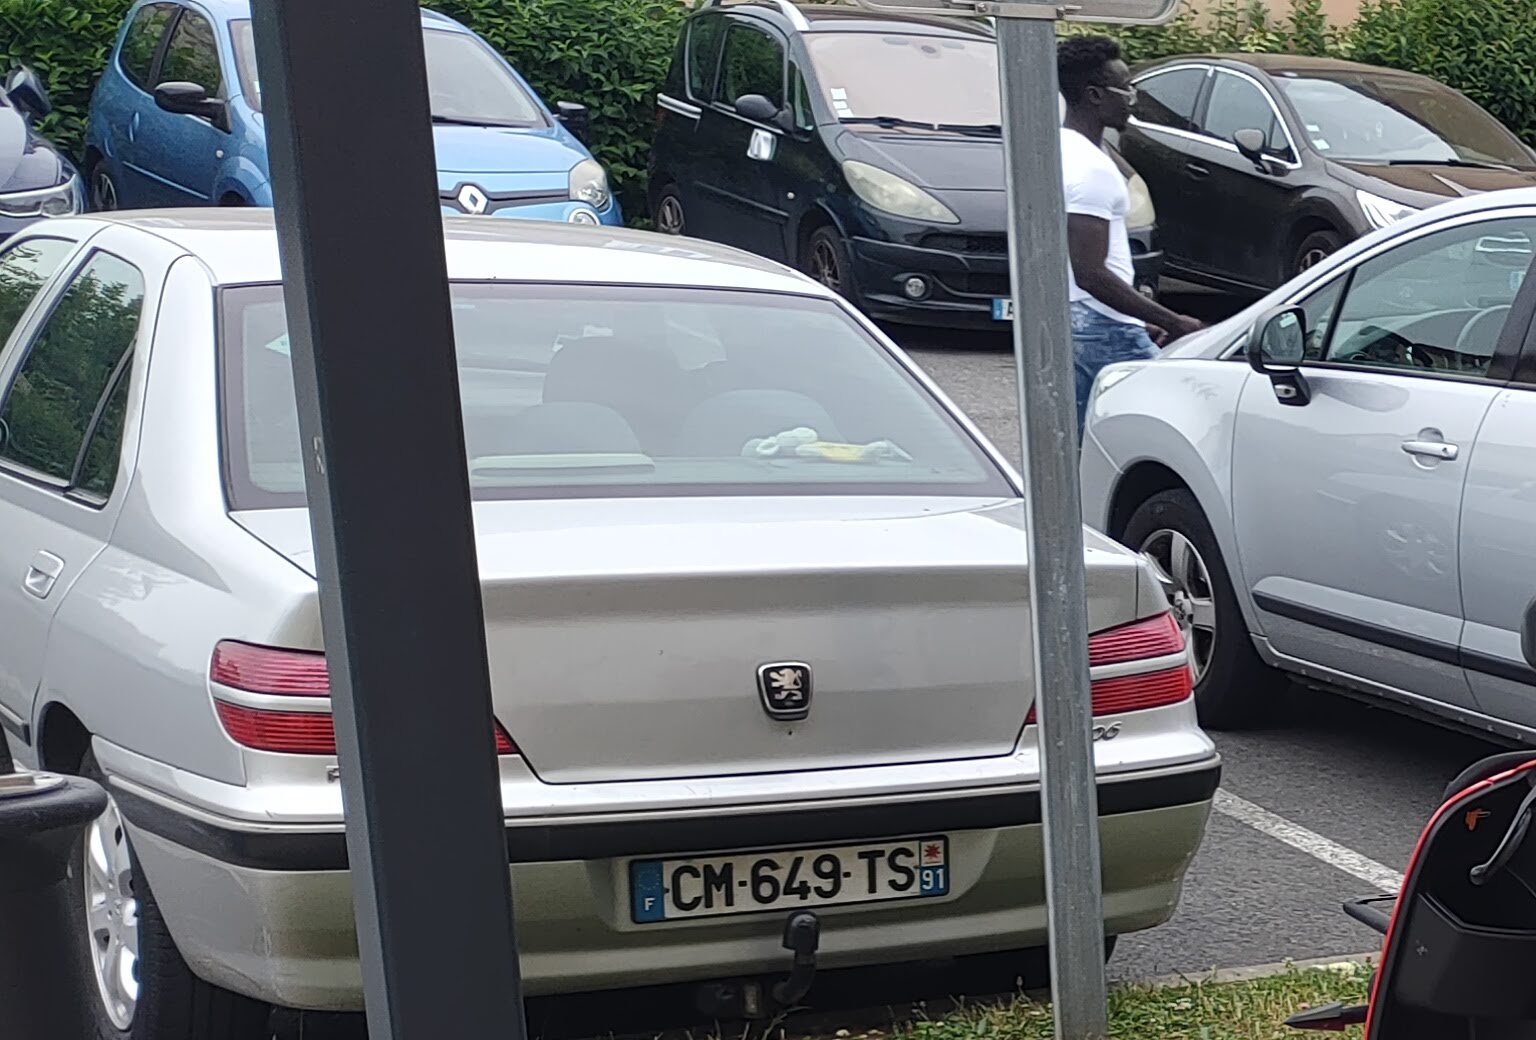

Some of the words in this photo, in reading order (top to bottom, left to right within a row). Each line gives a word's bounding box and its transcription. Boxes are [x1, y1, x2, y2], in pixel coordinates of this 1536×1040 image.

[1092, 721, 1123, 741] 06
[671, 847, 915, 911] CM-649-TS
[922, 868, 946, 891] 91
[644, 897, 655, 912] F
